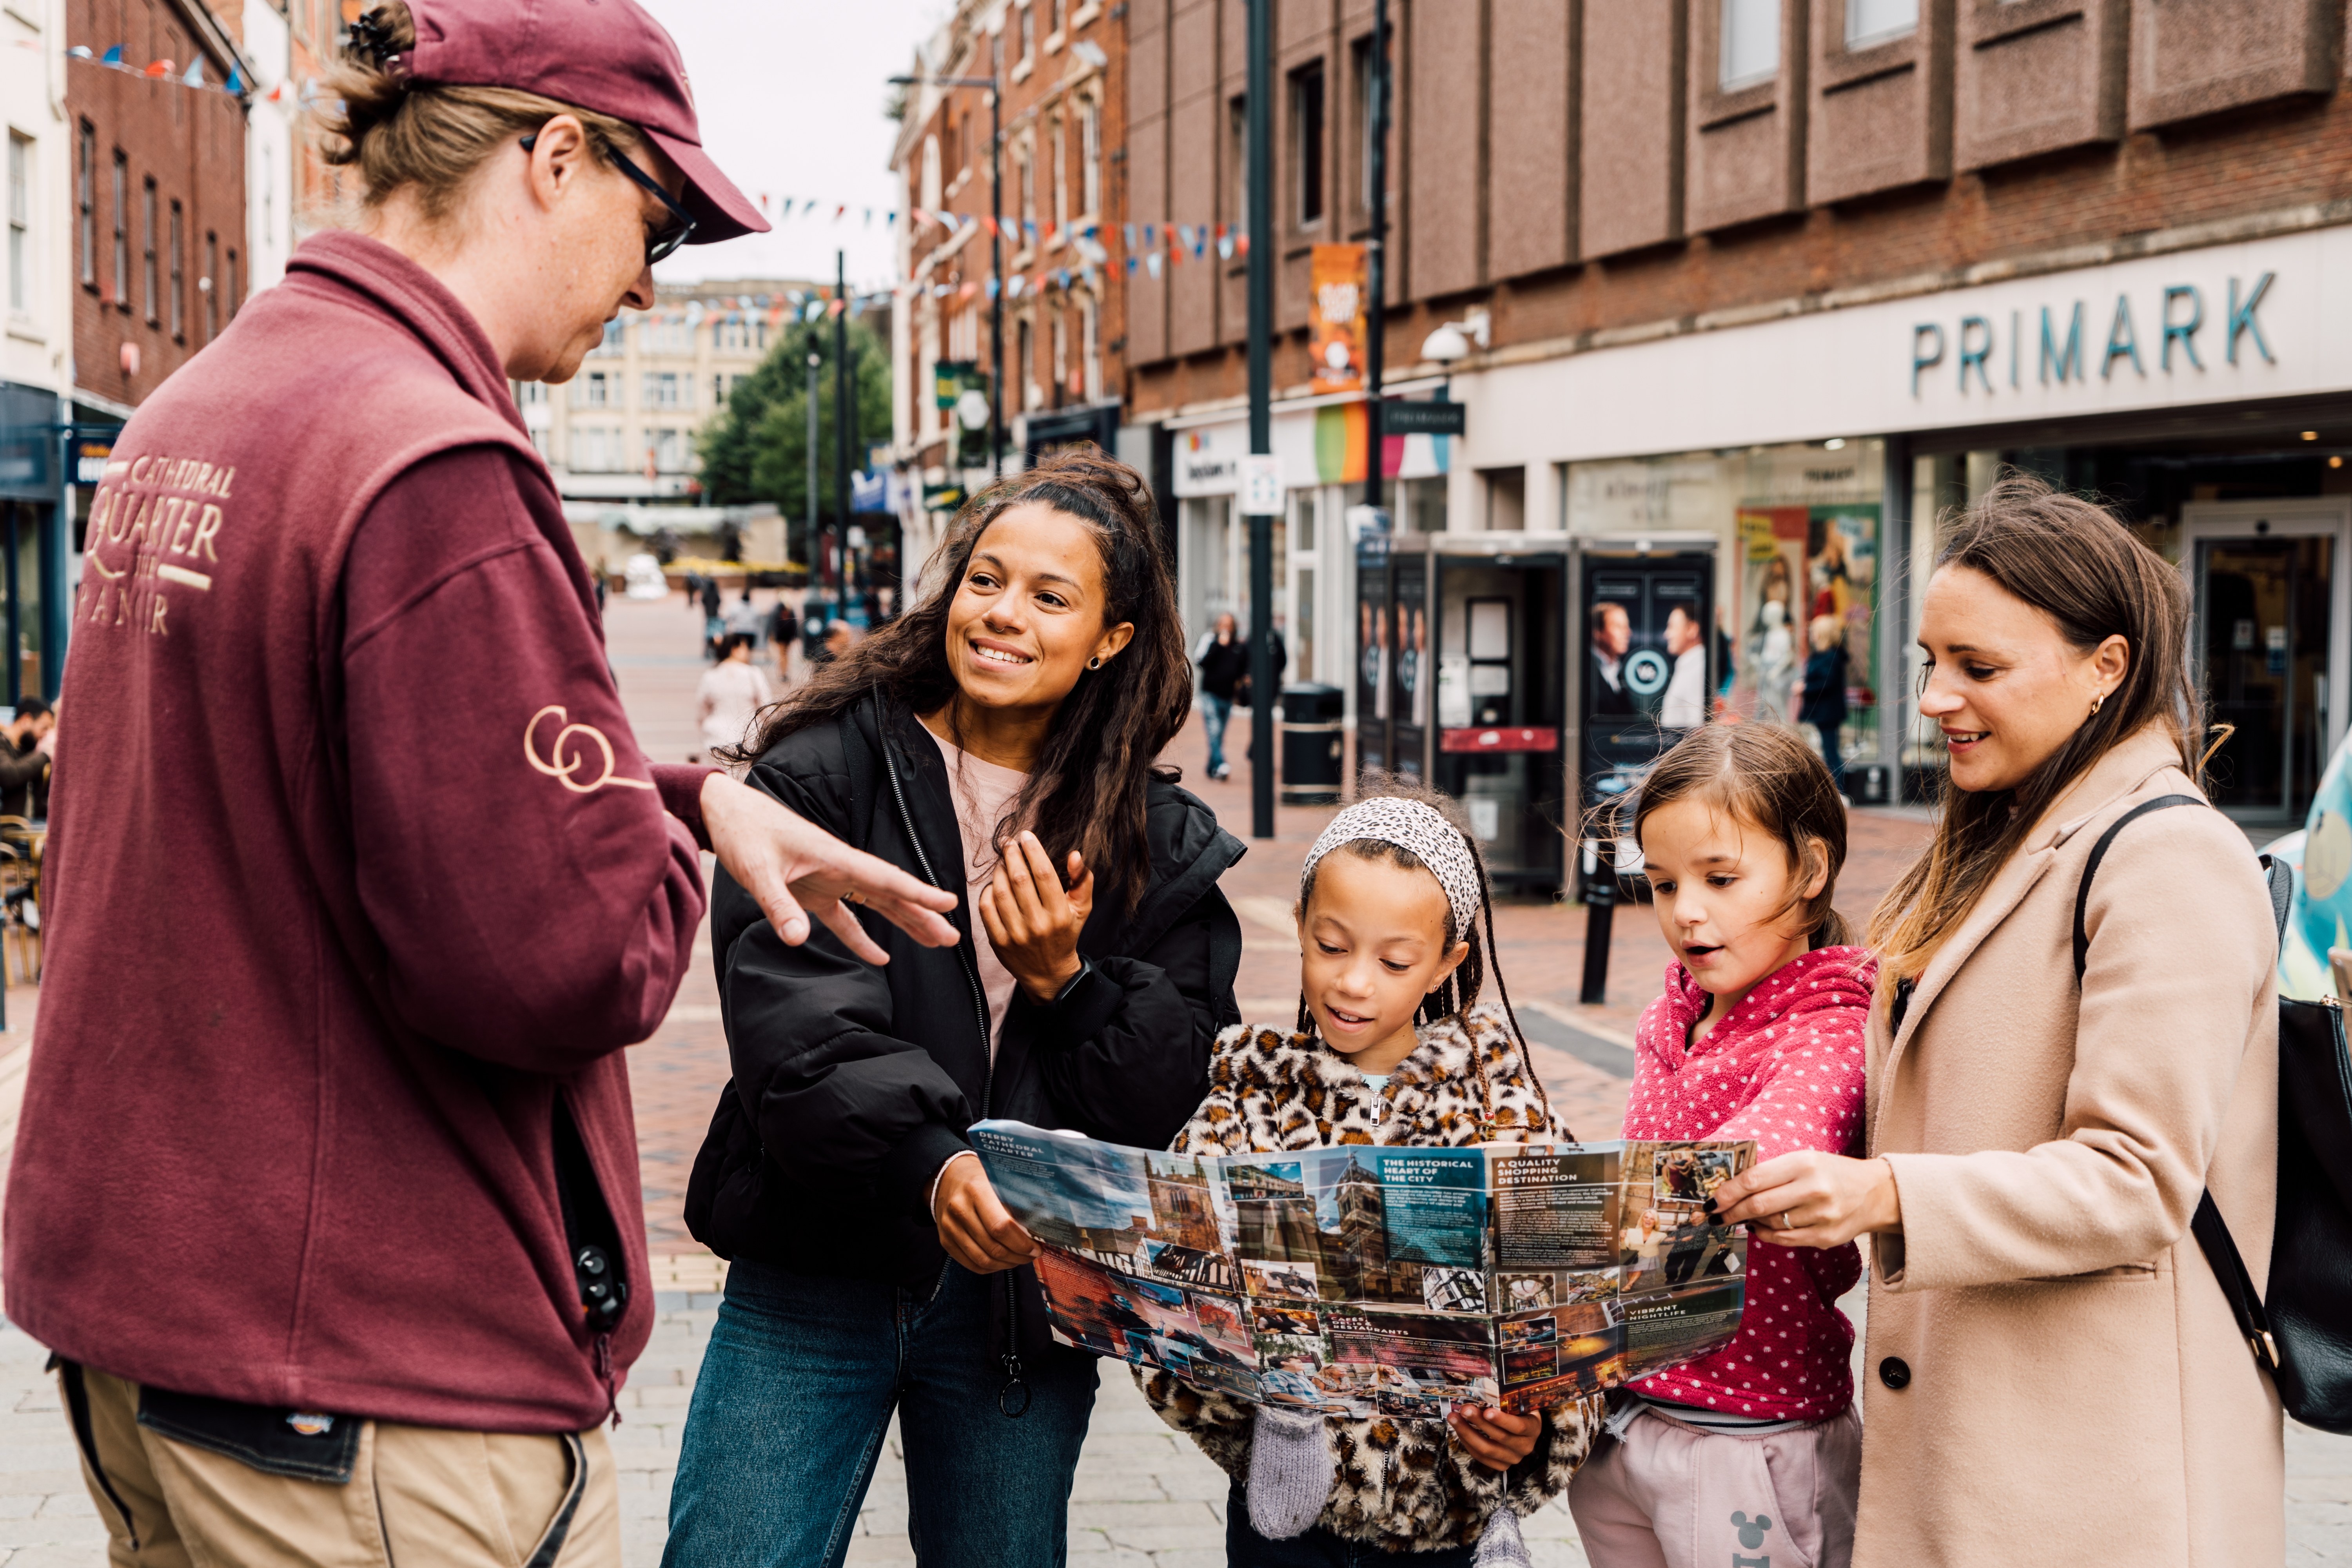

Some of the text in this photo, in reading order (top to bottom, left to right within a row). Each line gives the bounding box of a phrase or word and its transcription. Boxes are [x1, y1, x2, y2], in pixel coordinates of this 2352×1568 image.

[1911, 272, 2277, 396] PRIMARK
[131, 456, 236, 499] CATHEDRAL
[86, 485, 223, 579] QUARTER
[979, 1131, 1014, 1142] DERBY
[981, 1138, 1044, 1154] CATHEDRAL
[983, 1144, 1034, 1158] QUARTER
[1508, 1159, 1560, 1168] QUALITY
[1498, 1167, 1558, 1176] SHOPPING
[1498, 1174, 1577, 1184] DESTINATION
[1630, 1305, 1677, 1315] VIBRANT
[1630, 1310, 1686, 1321] NIGHTLIFE
[1334, 1325, 1408, 1335] RESTAURANTS
